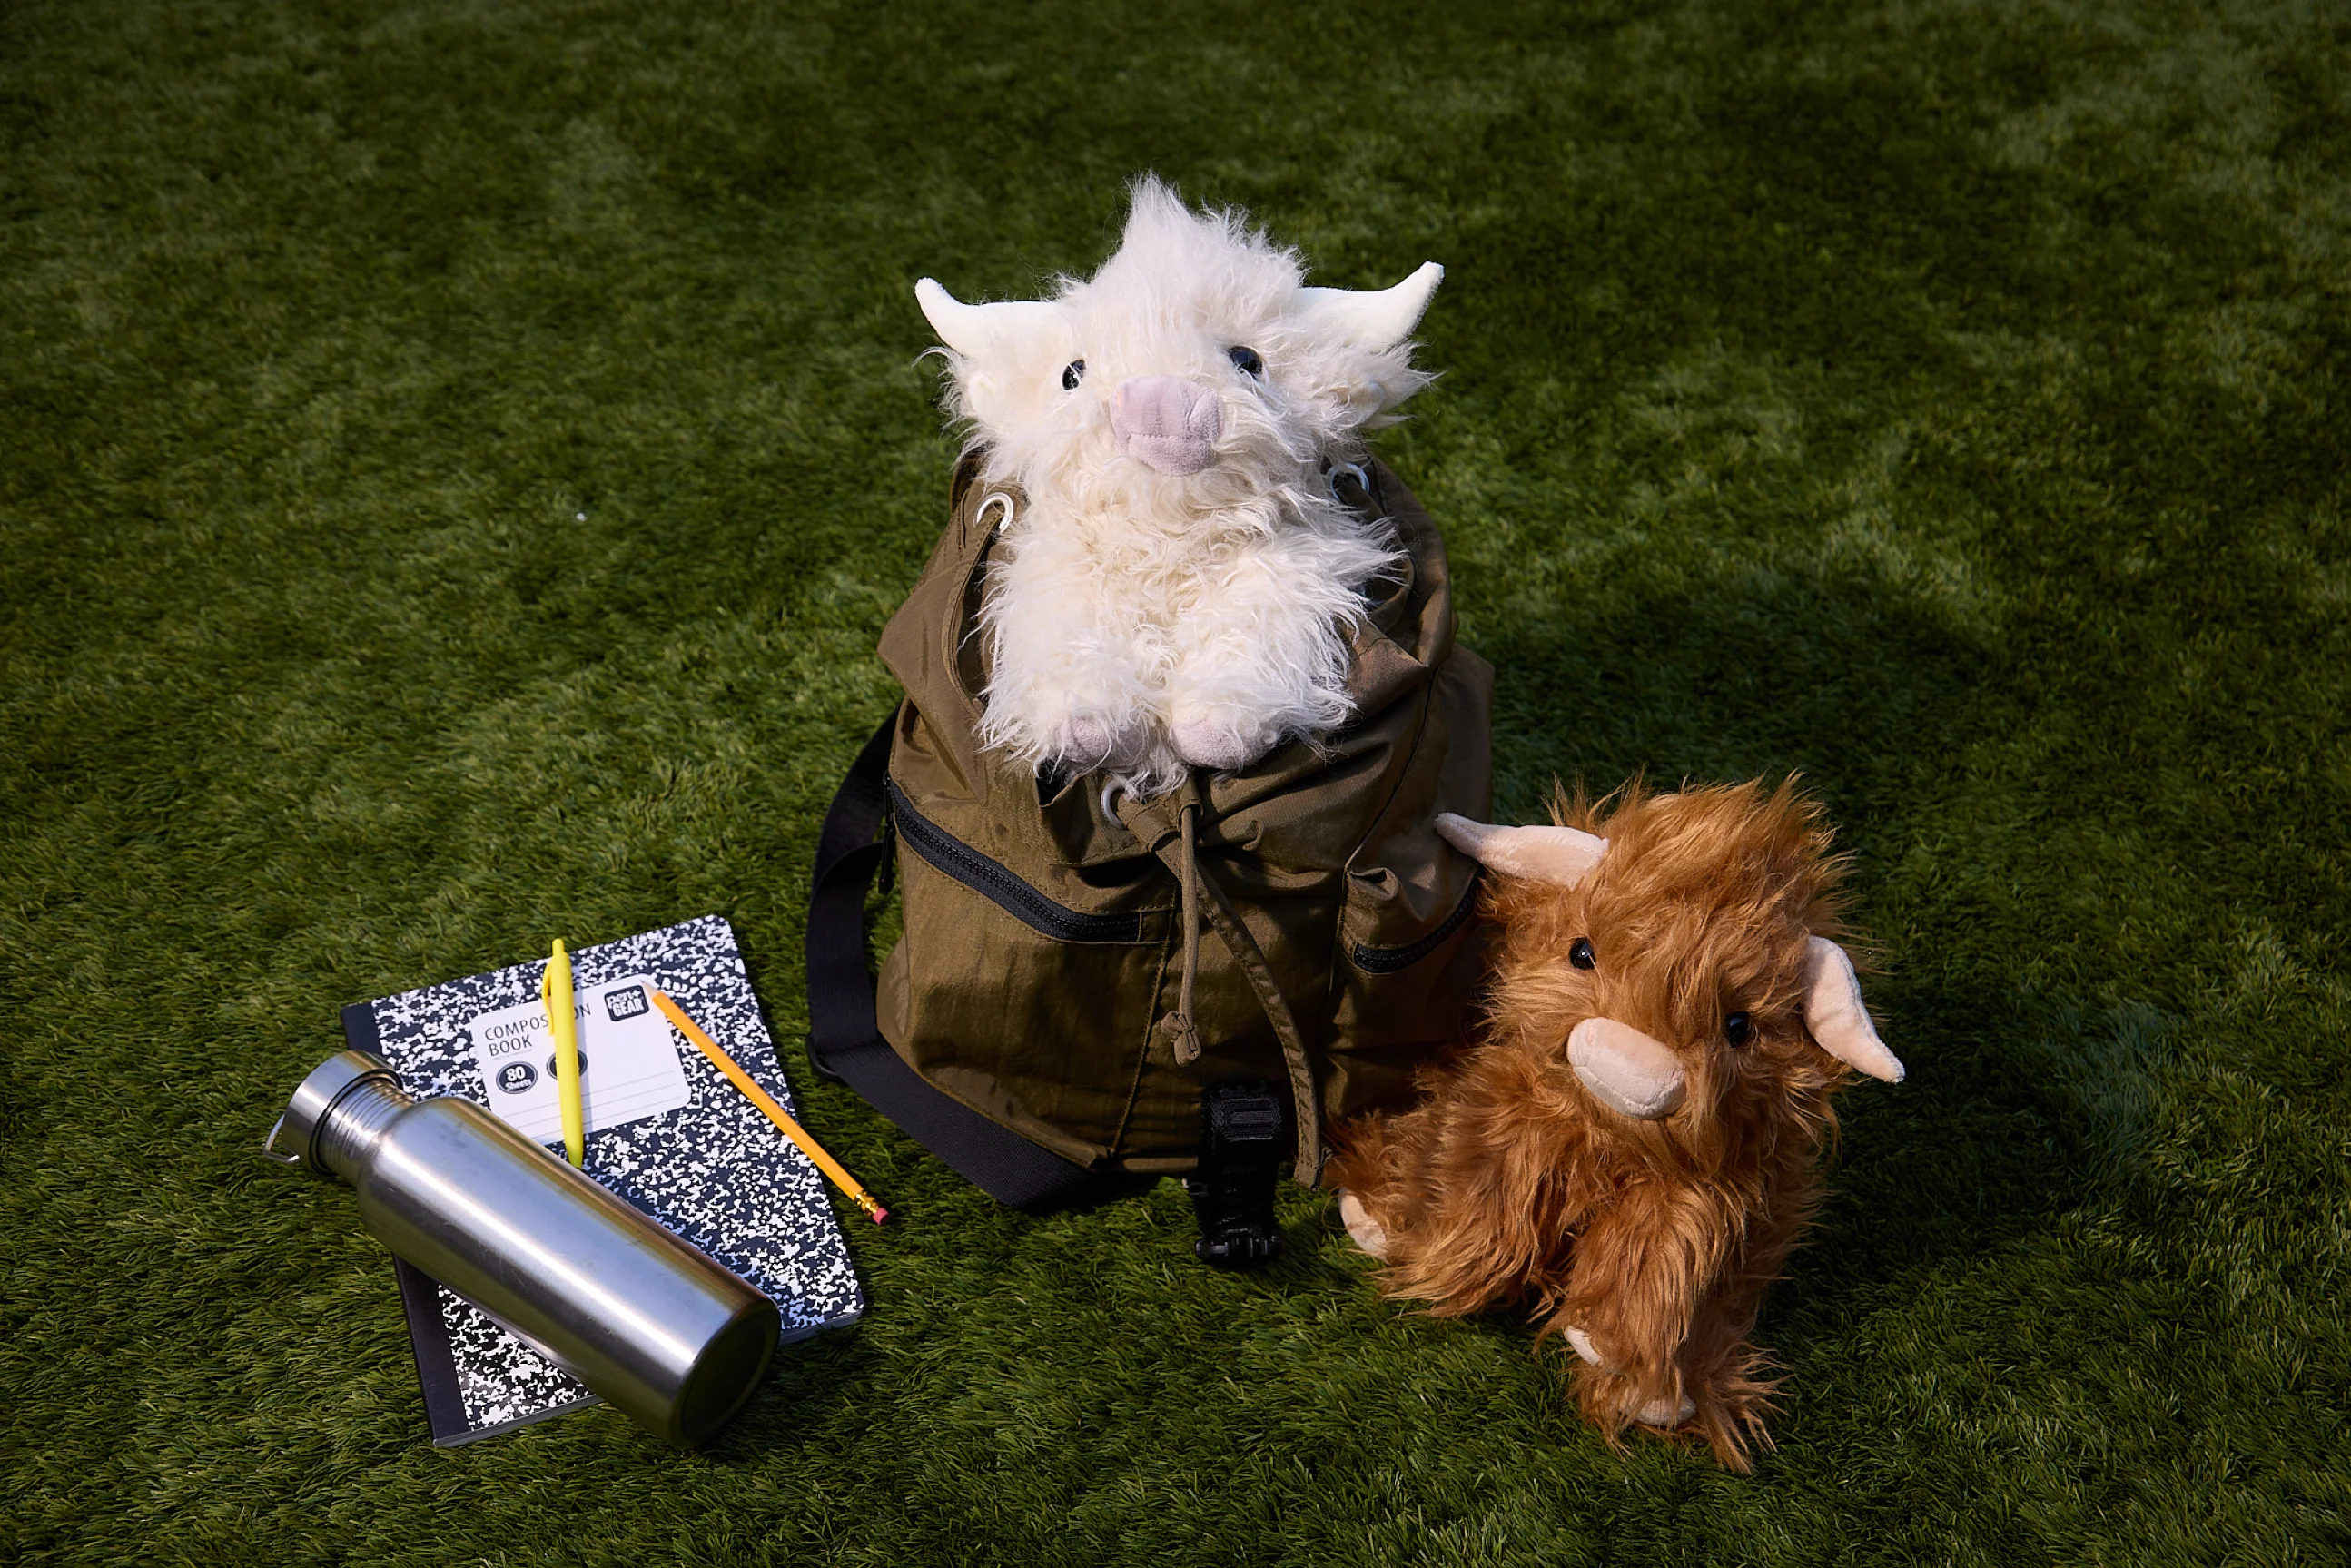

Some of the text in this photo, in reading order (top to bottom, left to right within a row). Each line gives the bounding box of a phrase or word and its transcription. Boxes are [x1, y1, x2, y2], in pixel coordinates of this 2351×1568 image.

[612, 998, 645, 1017] GEAR
[485, 1003, 591, 1040] COMPOSN
[489, 1034, 532, 1057] BOOK
[506, 1066, 526, 1082] 80
